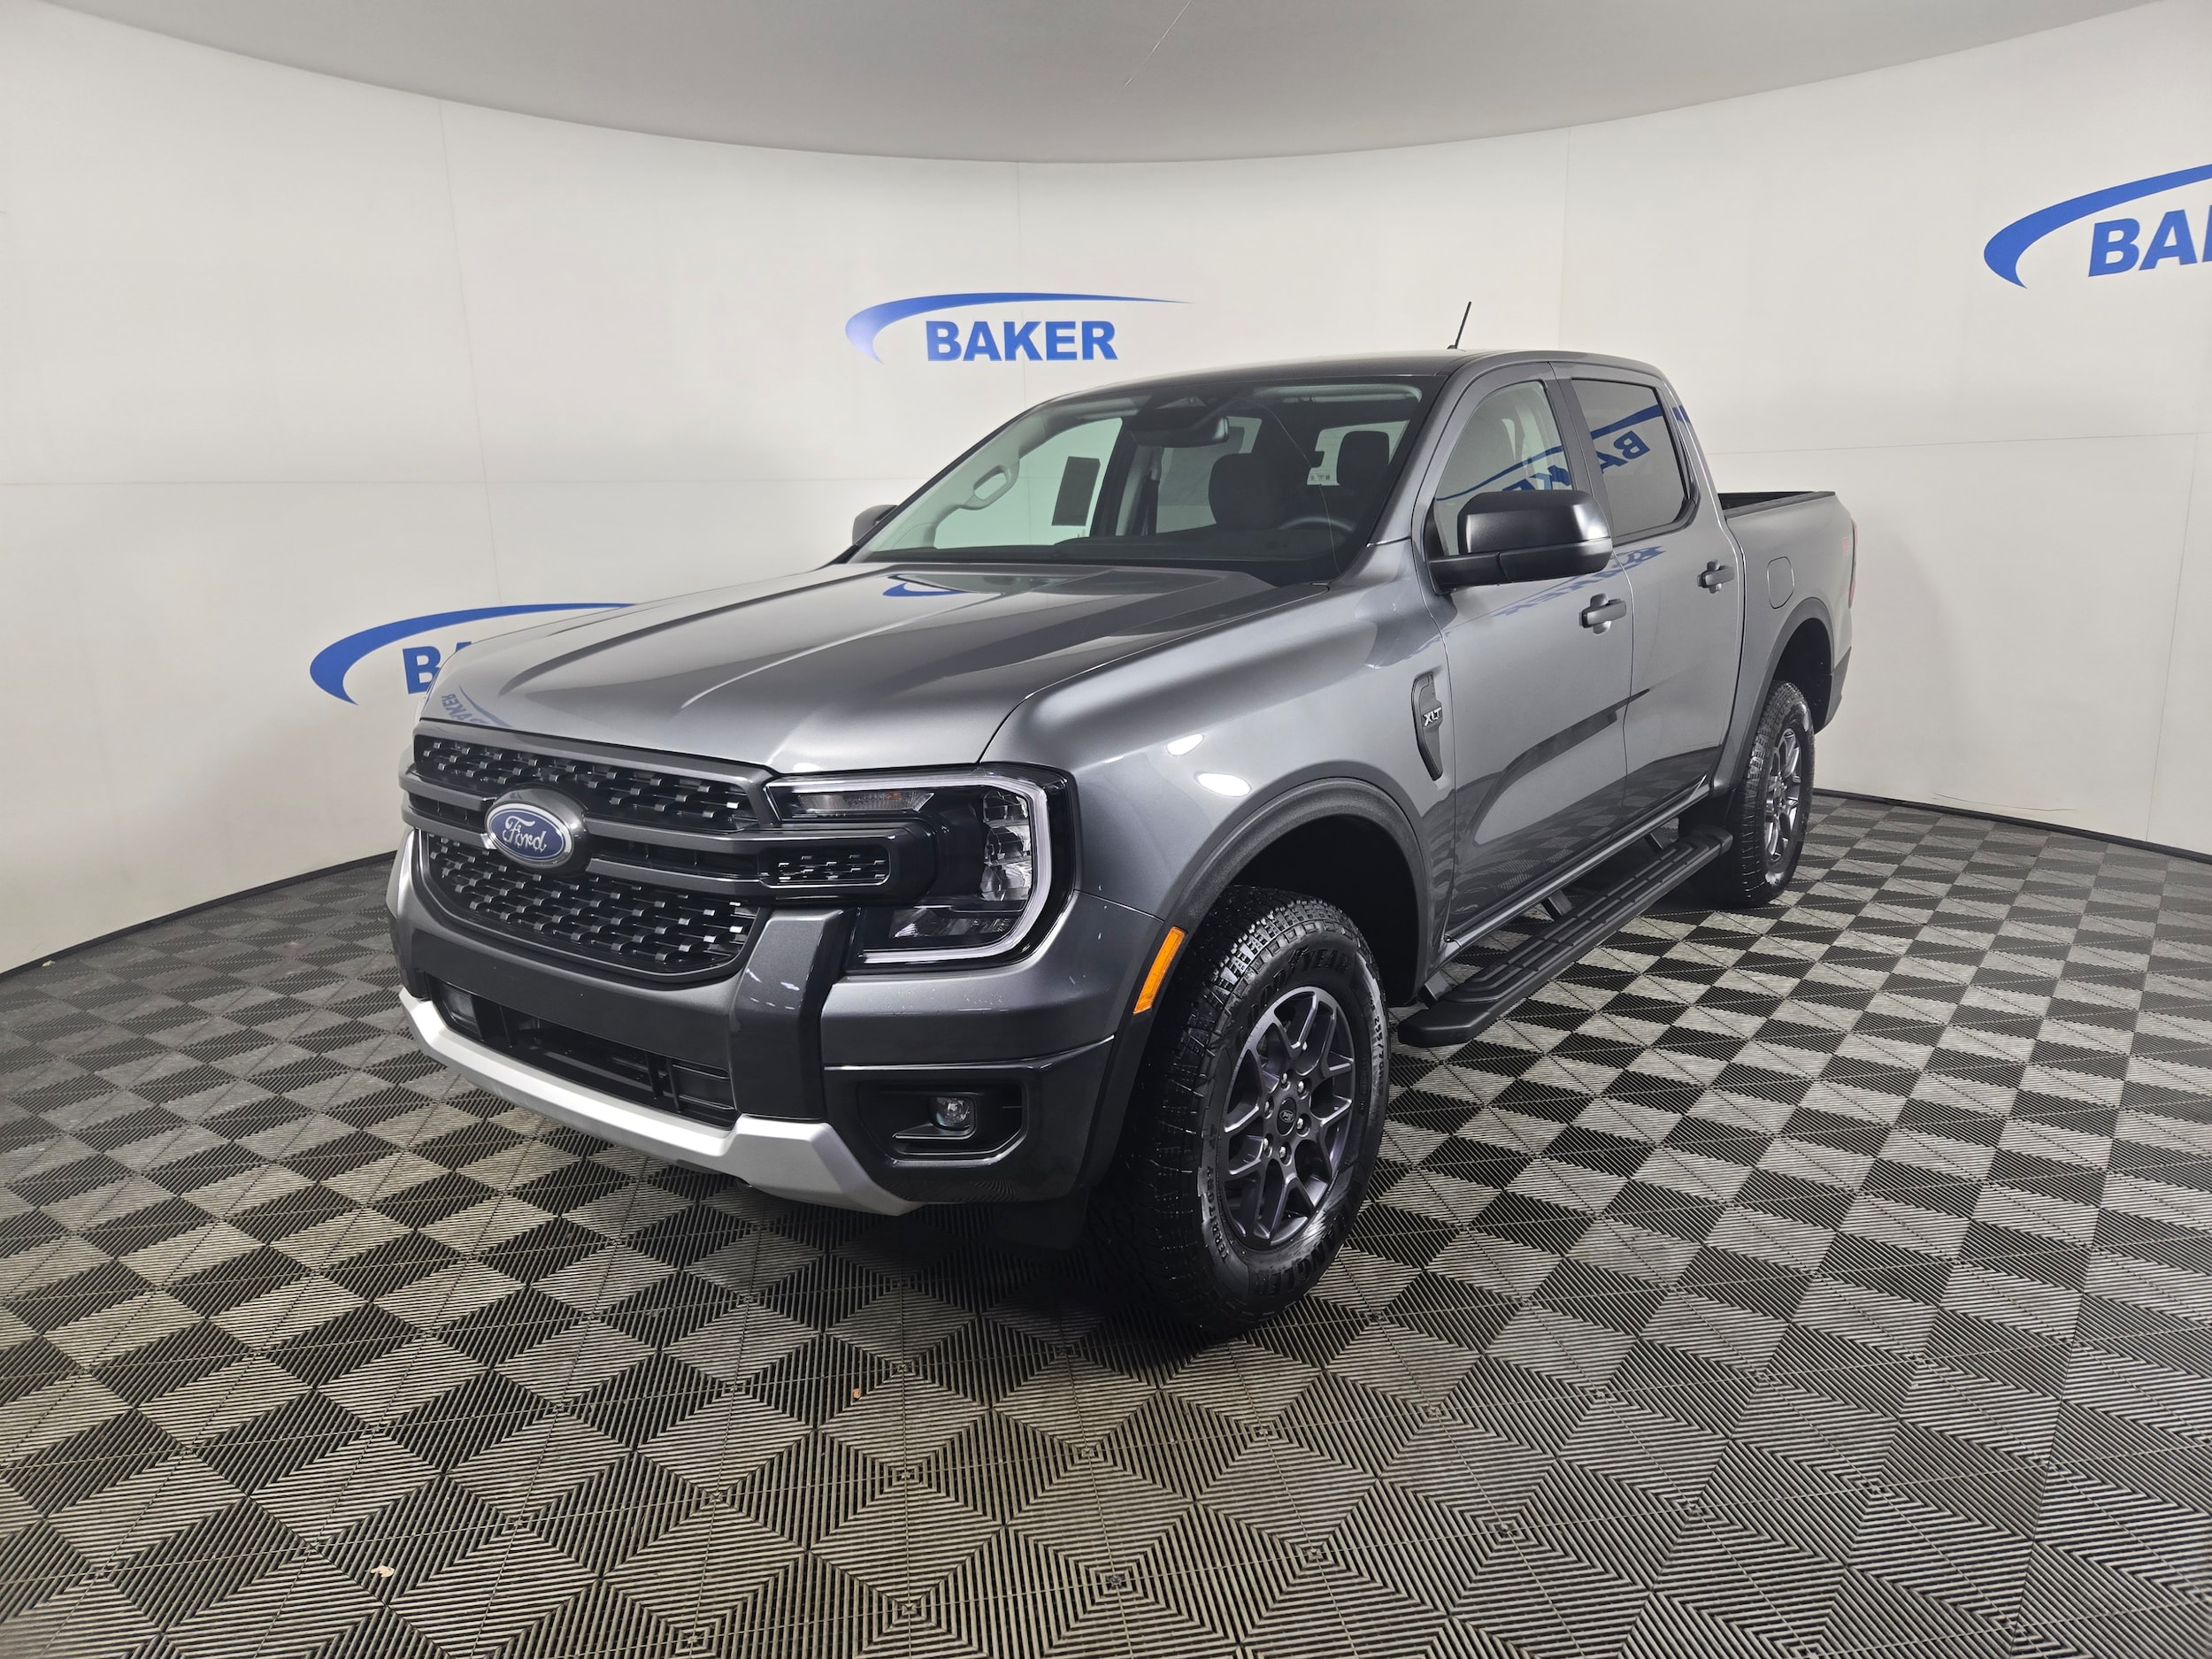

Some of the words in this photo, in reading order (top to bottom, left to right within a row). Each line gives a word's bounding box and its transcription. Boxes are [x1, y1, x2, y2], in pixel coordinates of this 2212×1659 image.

[926, 320, 1118, 361] BAKER
[403, 641, 472, 695] B
[1423, 707, 1442, 726] XLT
[502, 815, 548, 853] Ford
